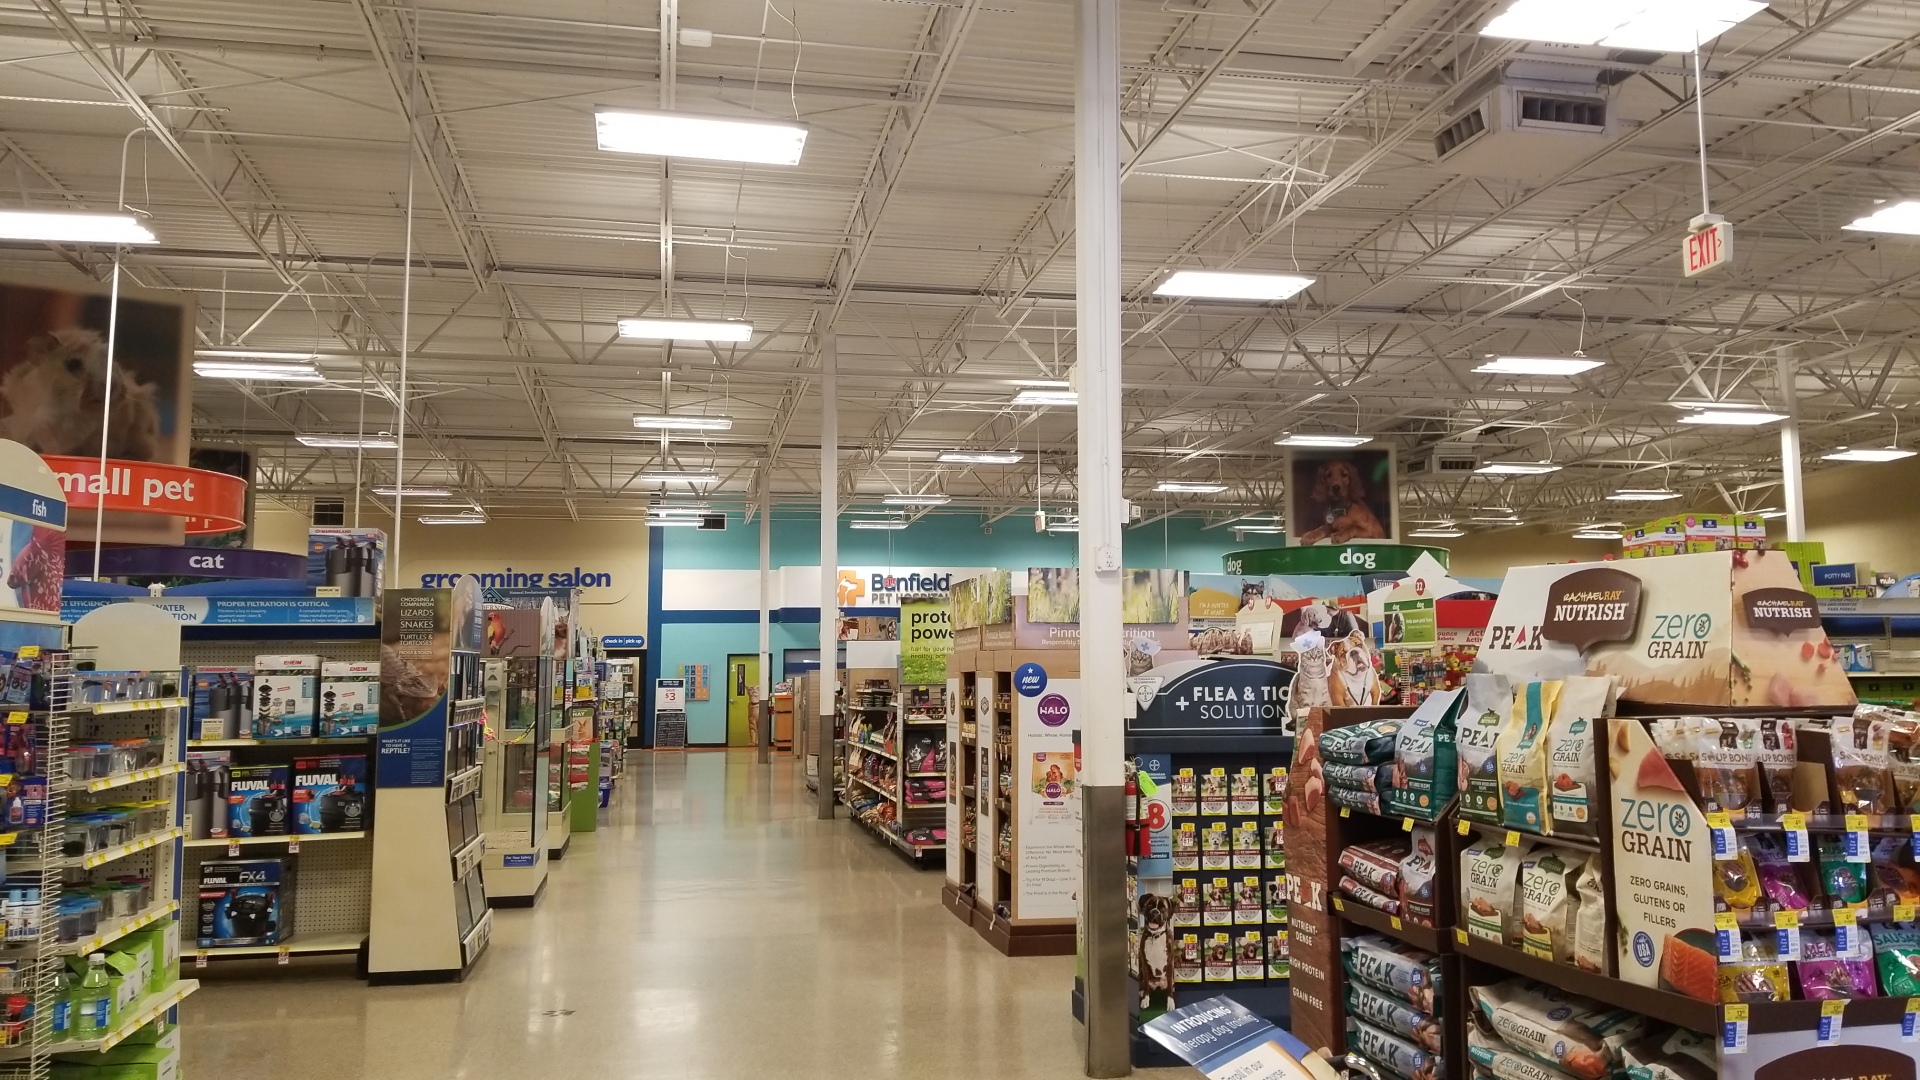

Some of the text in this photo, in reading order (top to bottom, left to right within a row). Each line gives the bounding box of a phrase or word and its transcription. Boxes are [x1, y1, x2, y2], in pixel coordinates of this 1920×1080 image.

[1689, 227, 1718, 271] EXIT
[55, 467, 195, 506] mall pet
[32, 499, 47, 517] fish
[189, 554, 225, 569] cat
[1227, 557, 1243, 574] dog
[1339, 548, 1377, 569] dog
[548, 567, 611, 588] salon
[1879, 577, 1896, 585] nulo
[1416, 582, 1423, 591] 32
[872, 593, 893, 605] PET
[1563, 591, 1622, 602] RACHAEL RAY
[401, 609, 434, 617] LIZARDS
[1416, 601, 1425, 610] dog
[1553, 602, 1627, 622] NUTRISH
[1753, 607, 1813, 618] NUTRISH
[400, 621, 434, 629] SNAKES
[1122, 628, 1155, 638] trition
[1651, 613, 1712, 639] zero
[625, 638, 635, 646] pick
[911, 628, 954, 643] powe
[1041, 639, 1076, 647] Responsibly
[1489, 625, 1544, 650] PEAK
[1647, 641, 1709, 659] GRAIN
[731, 664, 736, 672] 1
[1021, 675, 1040, 684] new
[665, 693, 676, 701] $3
[1193, 686, 1290, 702] FLEA & TIC
[1200, 705, 1287, 719] SOLUTION
[1438, 734, 1450, 742] PE
[1553, 752, 1581, 763] GRAIN
[1772, 754, 1795, 763] BONES
[1501, 763, 1526, 774] GRAIN
[231, 781, 270, 791] FLUVAL
[295, 774, 338, 786] FLUVAL
[1148, 803, 1165, 829] 8
[1621, 797, 1691, 837] zero
[1621, 830, 1692, 863] GRAIN
[239, 870, 266, 882] FX4
[1353, 860, 1376, 880] PEAK
[1471, 858, 1504, 877] zero
[1470, 872, 1499, 889] GRAIN
[1630, 875, 1689, 898] ZERO GRAINS,
[1285, 873, 1323, 912] PEAK
[1355, 887, 1378, 906] PEAK
[1523, 886, 1557, 907] GRAIN
[1633, 893, 1686, 914] GLUTENS OR
[1291, 917, 1318, 935] NUTRIENT-
[1643, 912, 1677, 929] FILLERS
[1295, 932, 1313, 946] DENSE
[1637, 942, 1652, 957] USA
[1804, 942, 1834, 955] MEA
[1289, 956, 1325, 981] HIGH PROTEIN
[1360, 953, 1397, 987] PEAK
[1292, 987, 1323, 1011] GRAIN FREE
[1362, 992, 1398, 1028] PEAK
[1169, 1006, 1232, 1035] INTRODUCING
[1179, 1013, 1260, 1052] therapy dog training
[1515, 1024, 1547, 1044] GRAIN
[1363, 1030, 1400, 1068] PEAK
[1240, 1060, 1265, 1076] in our
